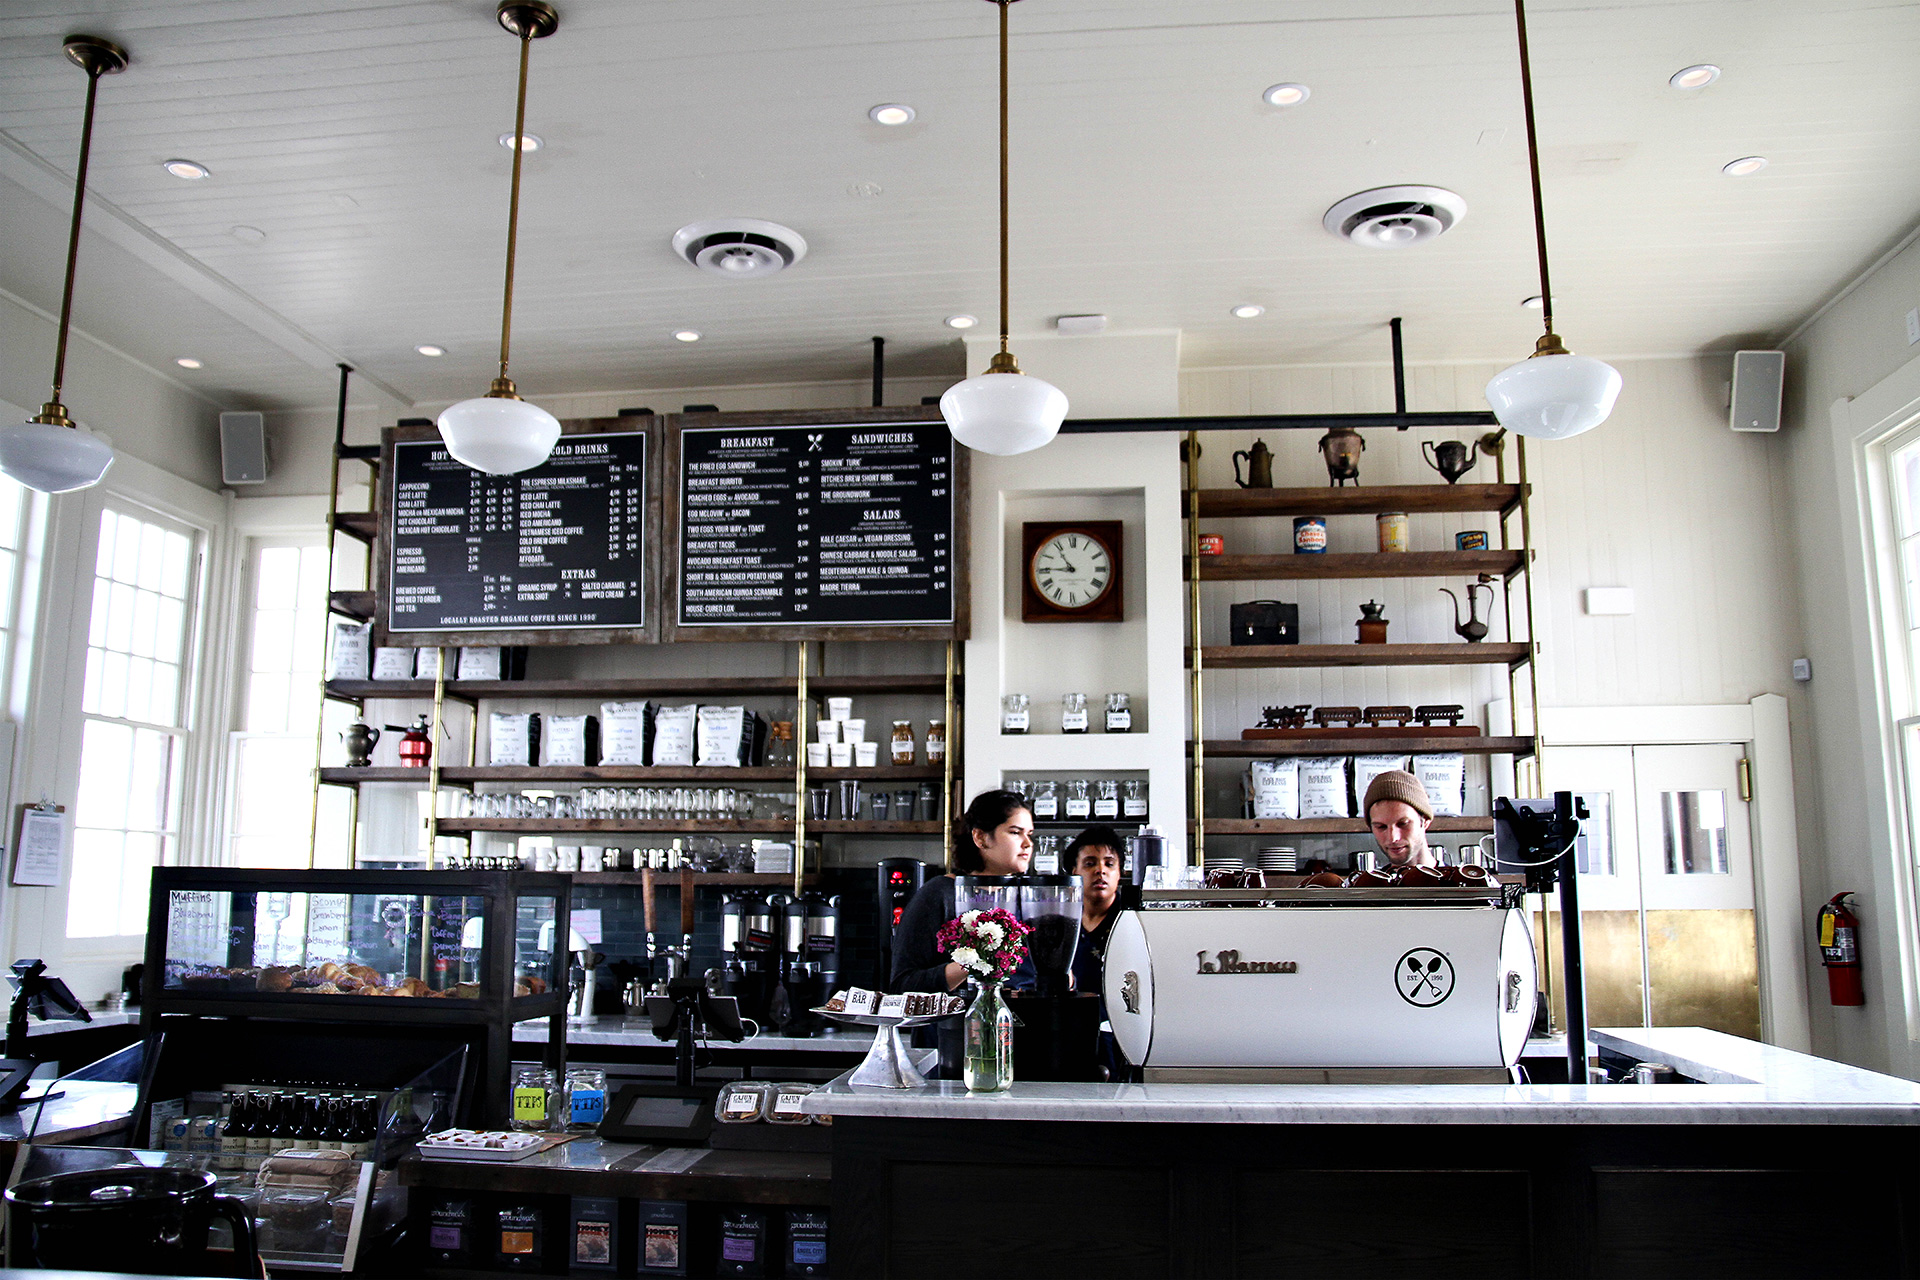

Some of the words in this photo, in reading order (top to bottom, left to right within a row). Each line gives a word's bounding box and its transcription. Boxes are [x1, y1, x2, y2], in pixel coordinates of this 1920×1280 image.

[721, 438, 774, 448] BREAKFAST
[852, 433, 913, 444] SANDWICHES
[551, 446, 572, 455] COLD
[574, 444, 608, 454] DRINKS
[432, 451, 448, 460] HOT
[532, 478, 556, 486] ESPRESSO
[864, 510, 901, 520] SALADS
[565, 526, 584, 534] COFFEE
[549, 536, 568, 544] COFFEE
[562, 570, 597, 579] EXTRAS
[172, 892, 212, 906] Muffins
[852, 994, 867, 1004] BAR
[516, 1096, 542, 1108] TIPS
[572, 1098, 602, 1110] TIPS
